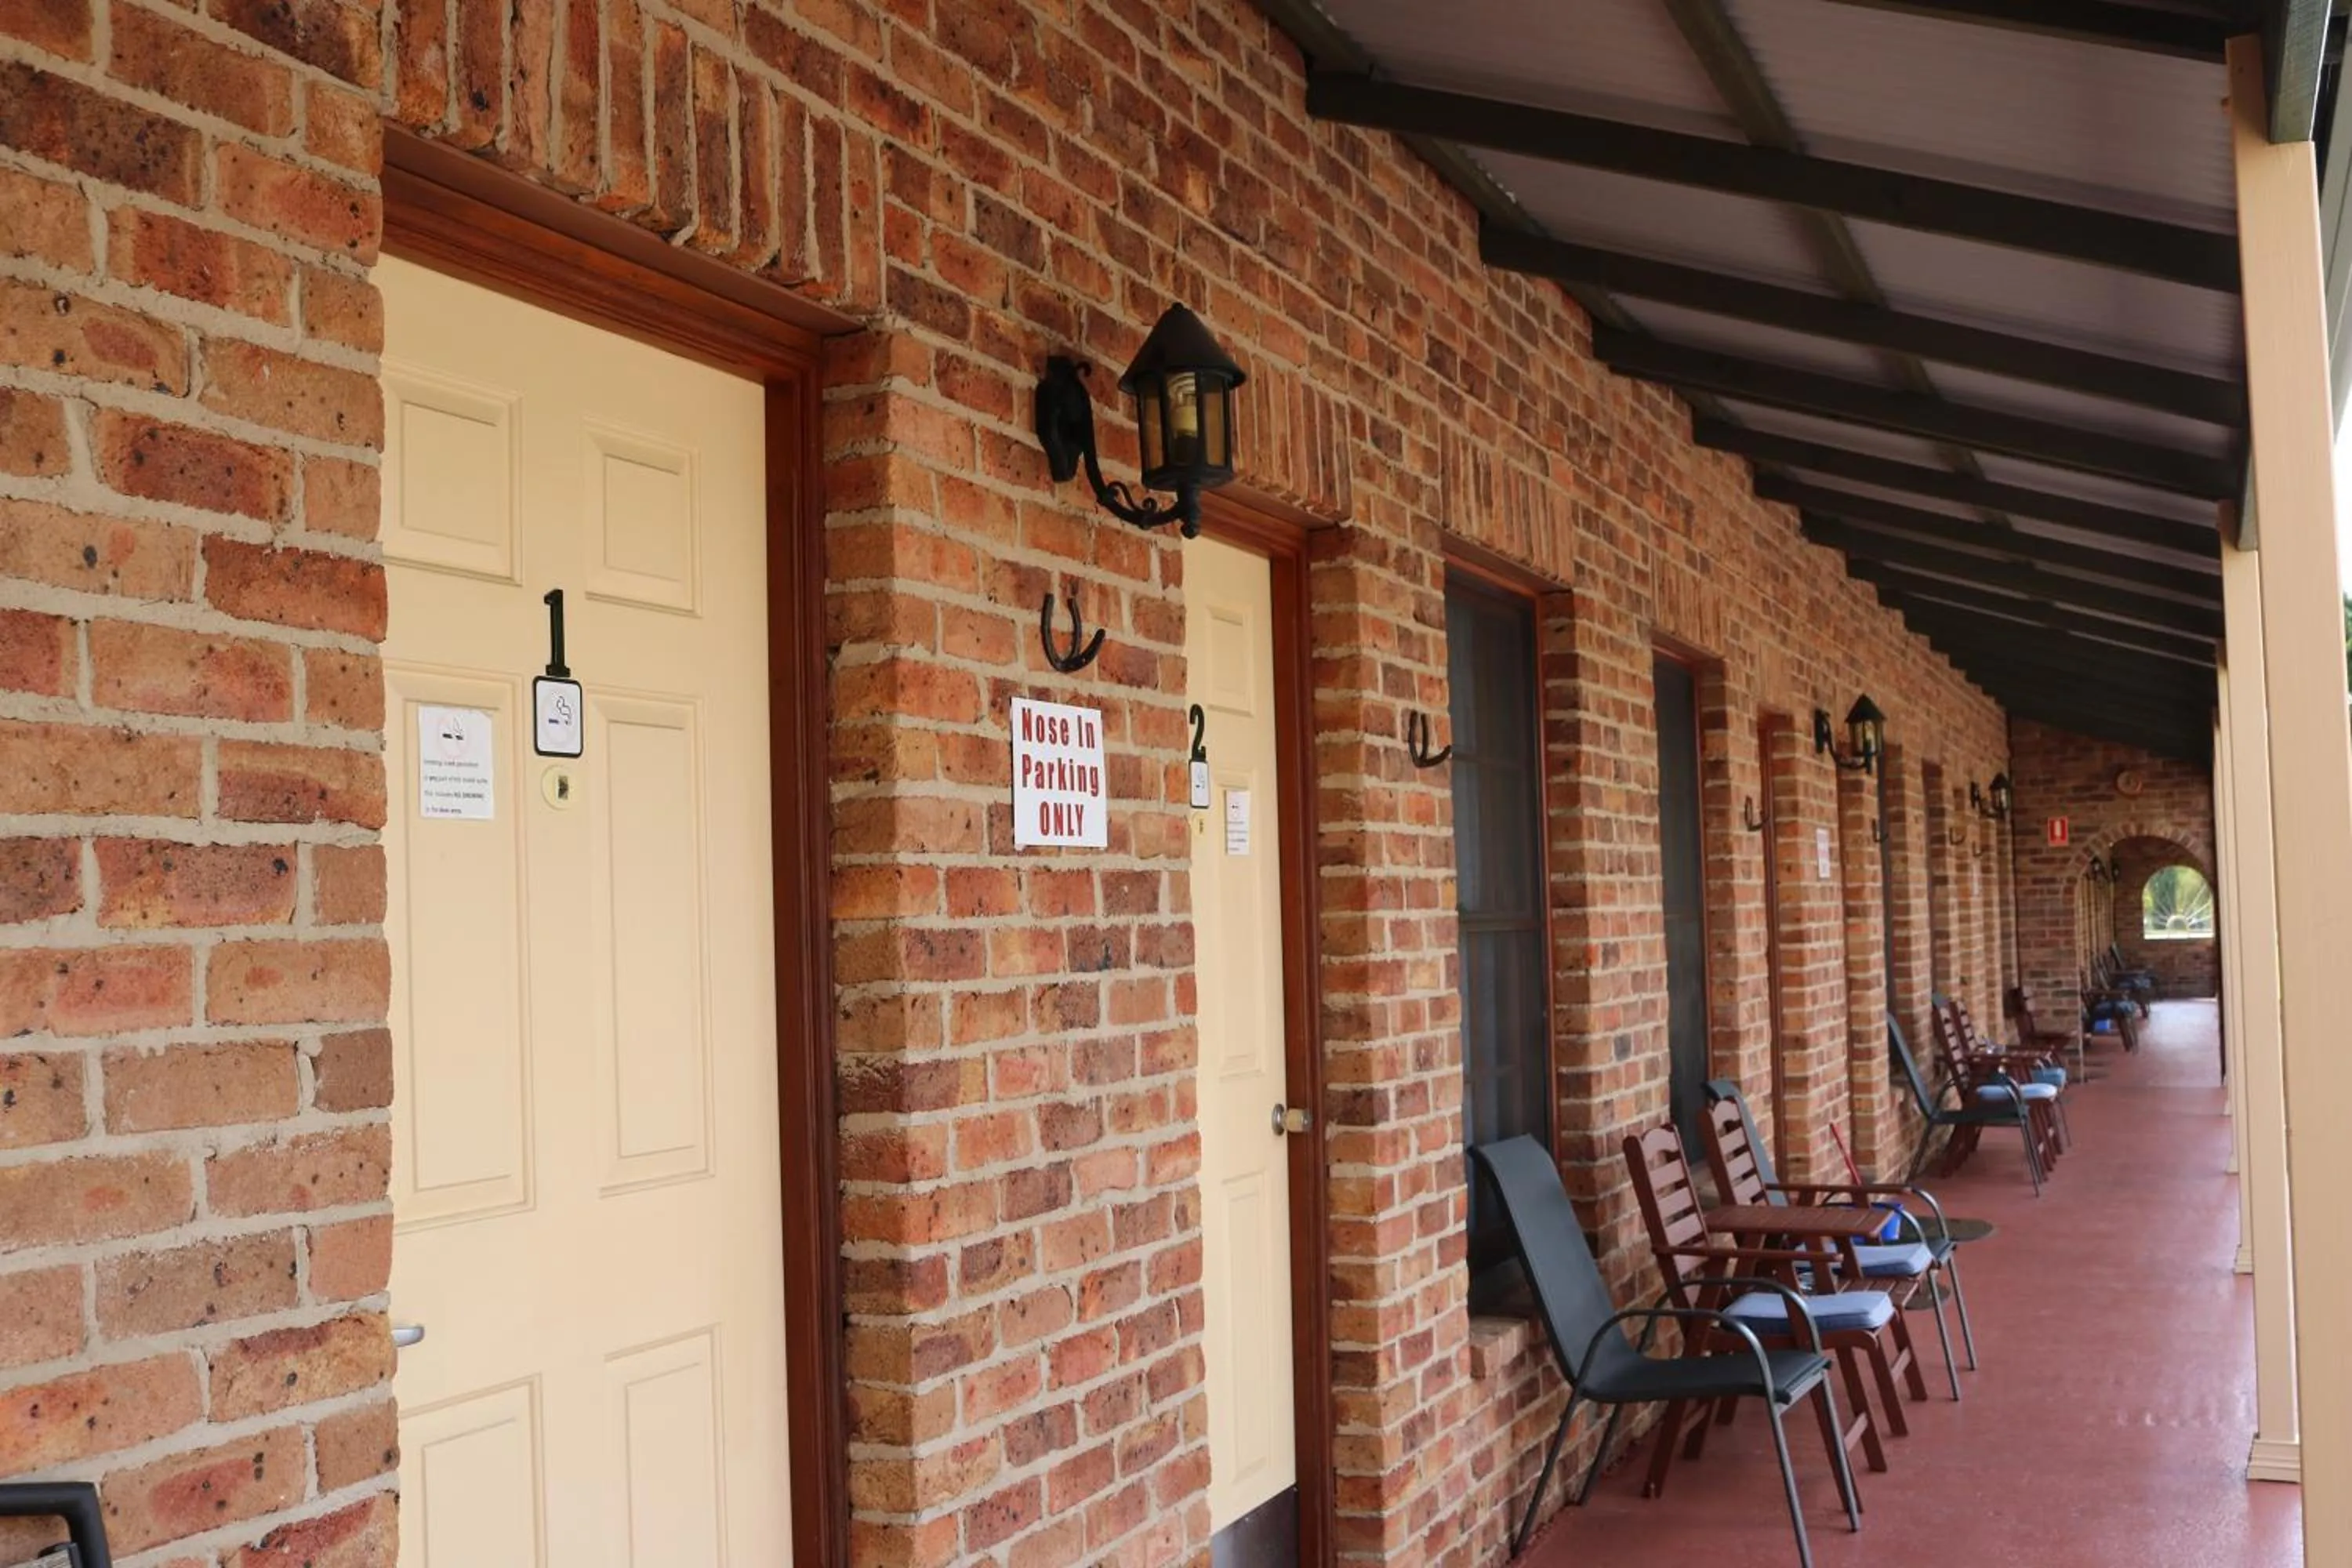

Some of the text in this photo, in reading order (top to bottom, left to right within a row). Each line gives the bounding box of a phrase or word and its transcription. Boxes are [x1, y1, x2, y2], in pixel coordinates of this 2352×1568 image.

[543, 588, 571, 677] 1
[1022, 706, 1095, 750] Nose In
[1189, 703, 1207, 761] 2
[1022, 753, 1099, 797] Parking
[1040, 800, 1084, 837] ONLY
